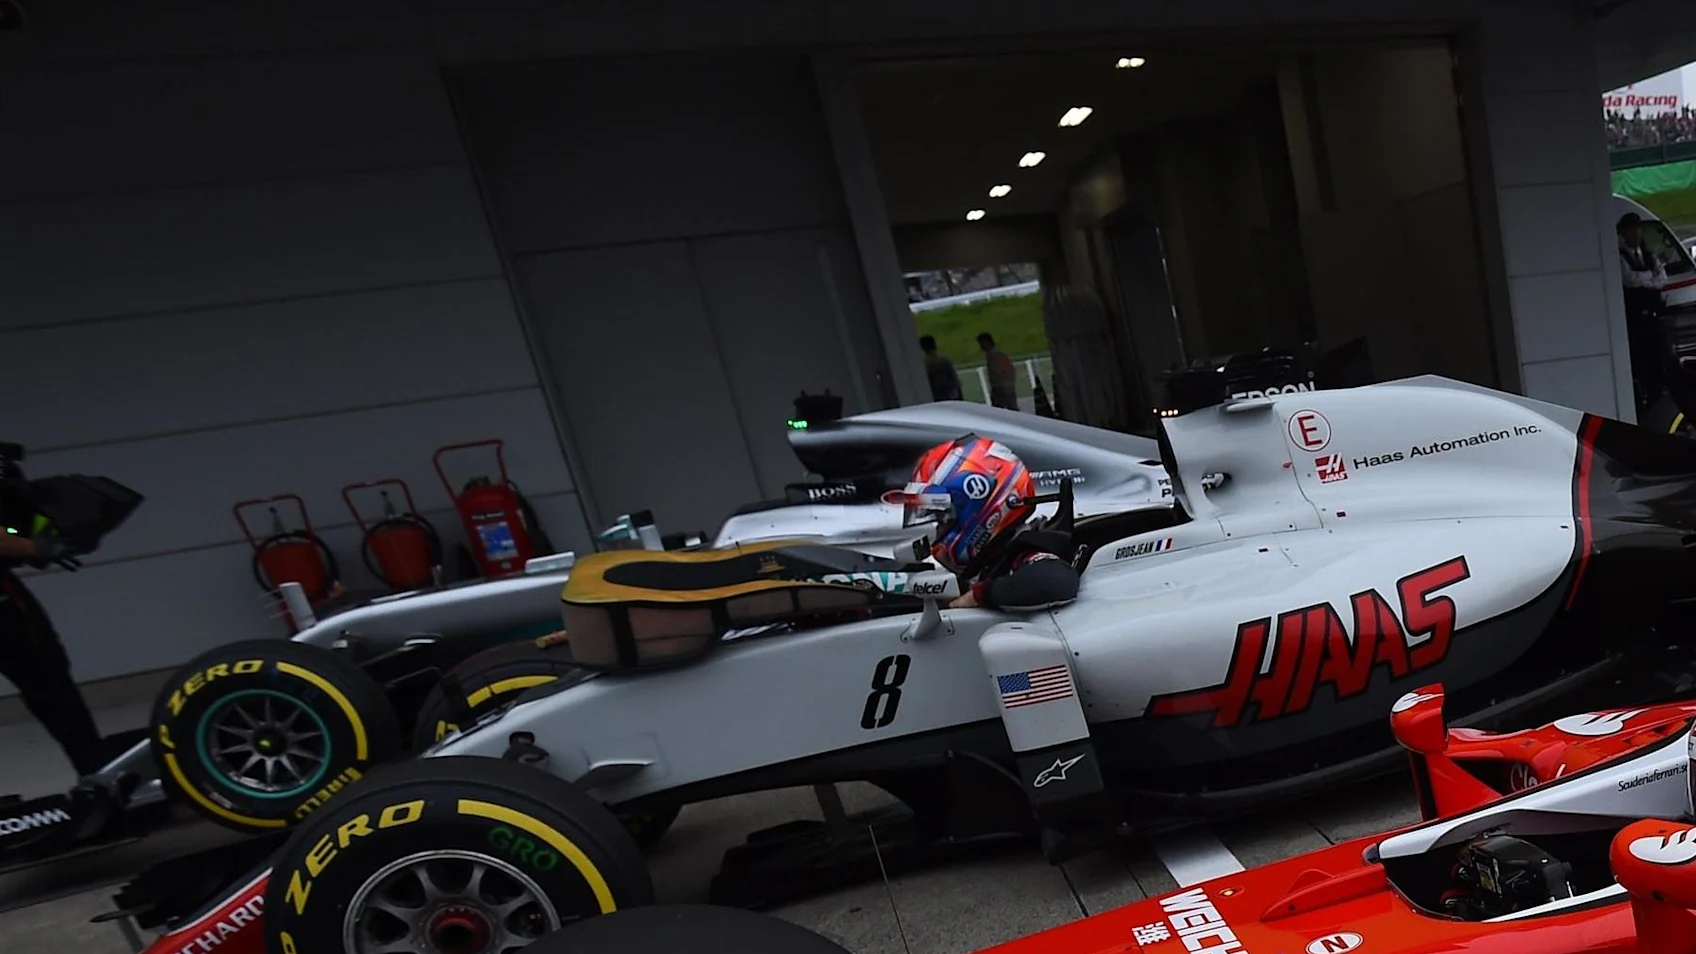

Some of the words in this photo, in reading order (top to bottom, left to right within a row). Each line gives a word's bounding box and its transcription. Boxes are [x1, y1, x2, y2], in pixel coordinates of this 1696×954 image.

[1625, 95, 1678, 108] Racing
[1297, 415, 1322, 446] E
[1353, 451, 1404, 470] Haas
[1409, 430, 1511, 459] Automation
[1514, 424, 1542, 438] Inc.
[808, 483, 857, 500] BOSS
[1115, 540, 1155, 560] GROSJEAN
[913, 574, 948, 590] telcel
[1145, 555, 1470, 728] HAAS
[166, 659, 264, 717] ZERO
[860, 654, 911, 729] 8
[285, 800, 426, 915] ZERO
[488, 825, 560, 872] GRO
[1320, 935, 1350, 953] N
